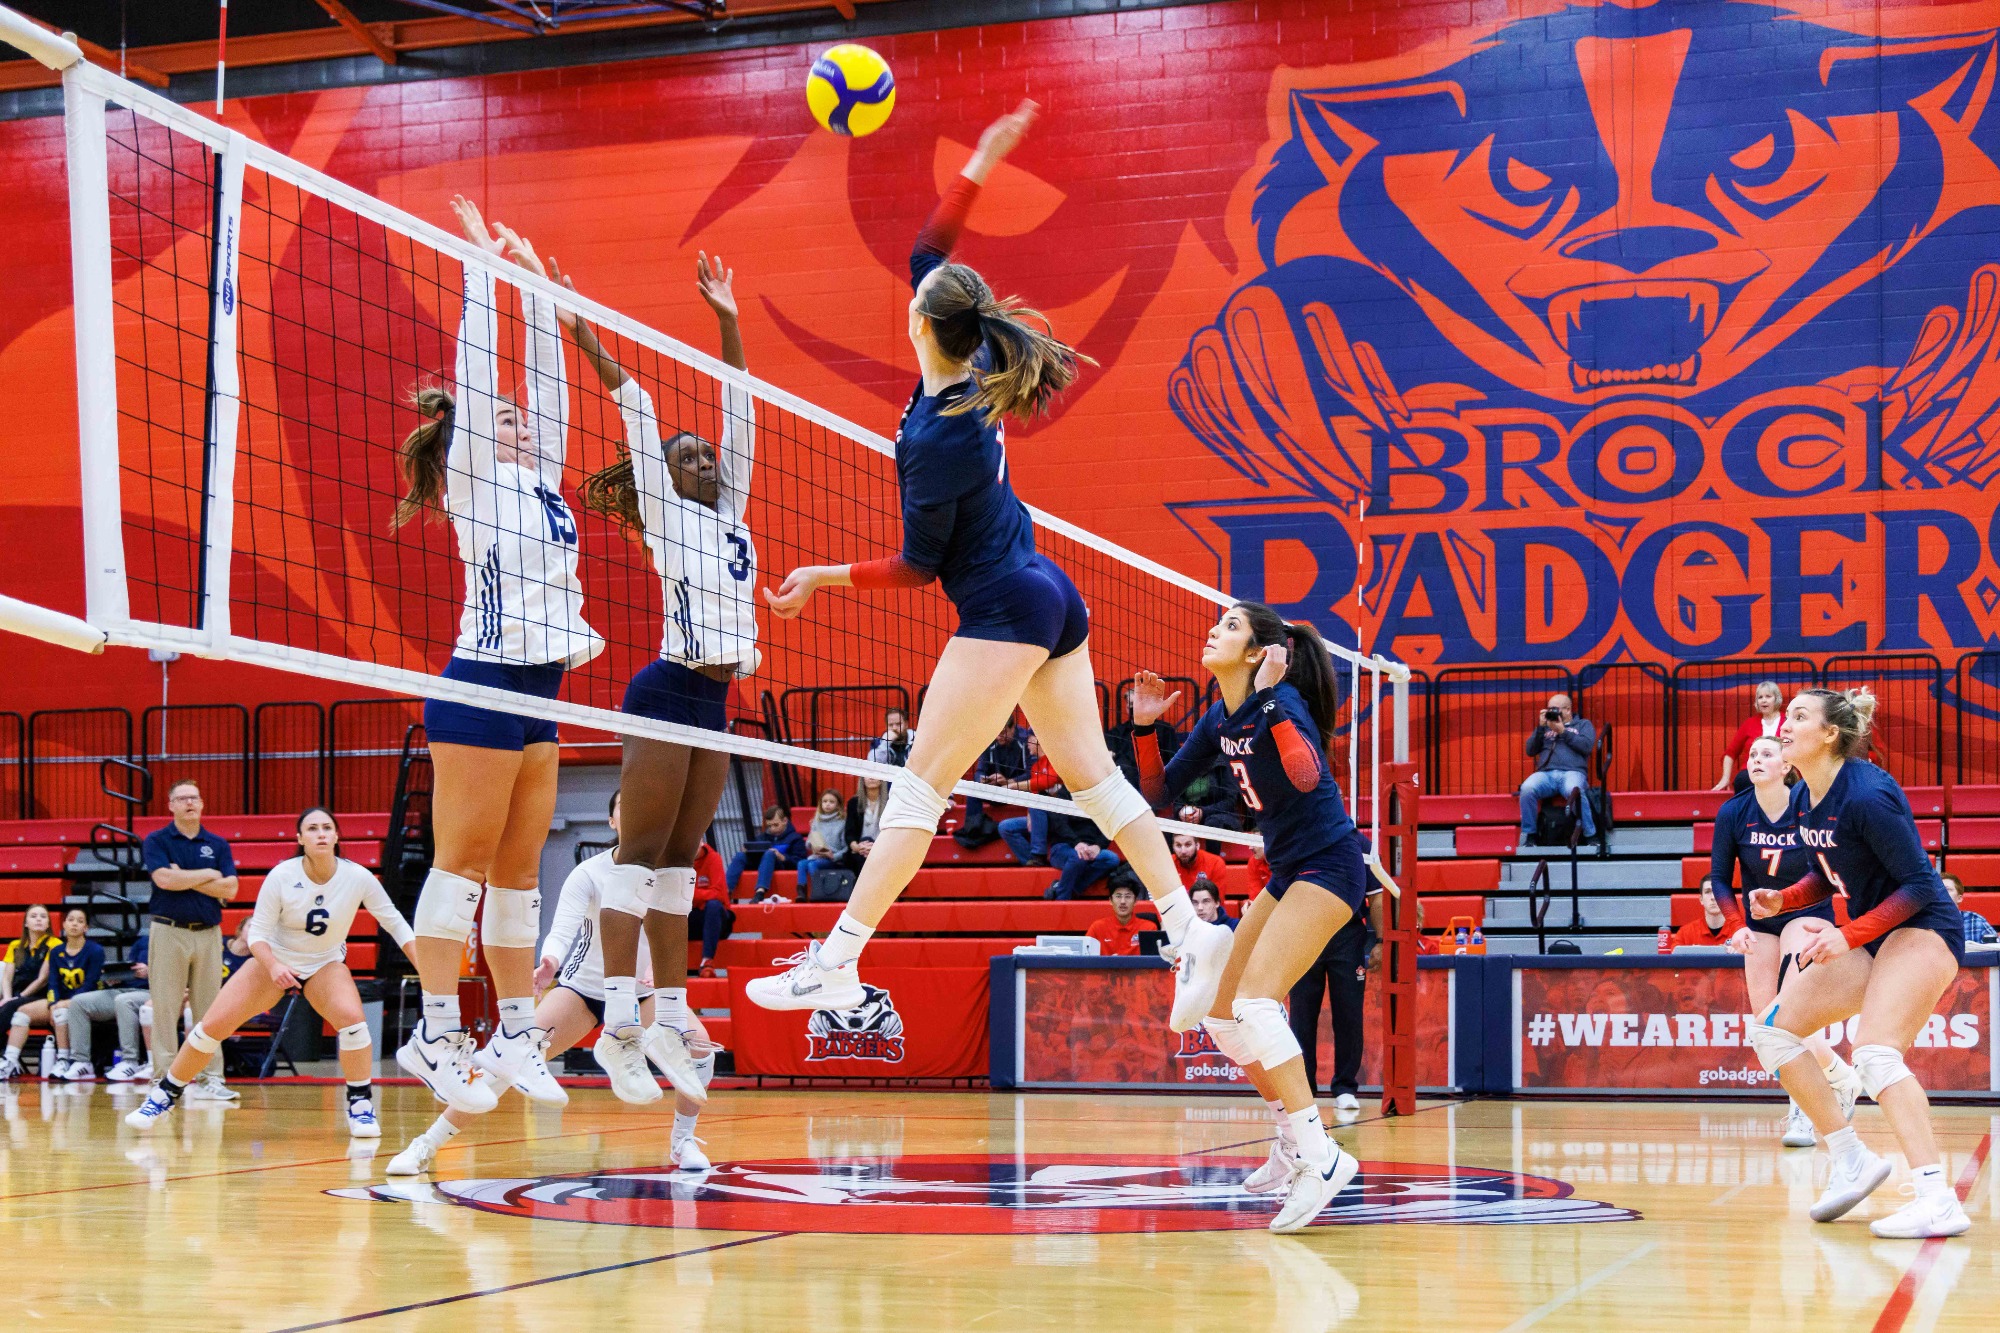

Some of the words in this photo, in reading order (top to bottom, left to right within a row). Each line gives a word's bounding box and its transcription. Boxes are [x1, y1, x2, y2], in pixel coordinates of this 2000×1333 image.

[226, 215, 234, 278] SPORTS
[1367, 395, 1945, 516] BROCK
[534, 486, 577, 545] 15
[725, 532, 751, 581] 3
[1208, 508, 2000, 672] BADGER
[1220, 736, 1254, 756] BROCK
[1229, 759, 1263, 812] 3
[1750, 831, 1796, 846] BROCK
[1761, 847, 1783, 877] 7
[1816, 851, 1851, 899] 4
[305, 908, 329, 936] 6
[809, 1037, 903, 1061] BADGERS
[1527, 1013, 1980, 1049] #WEAREDRS
